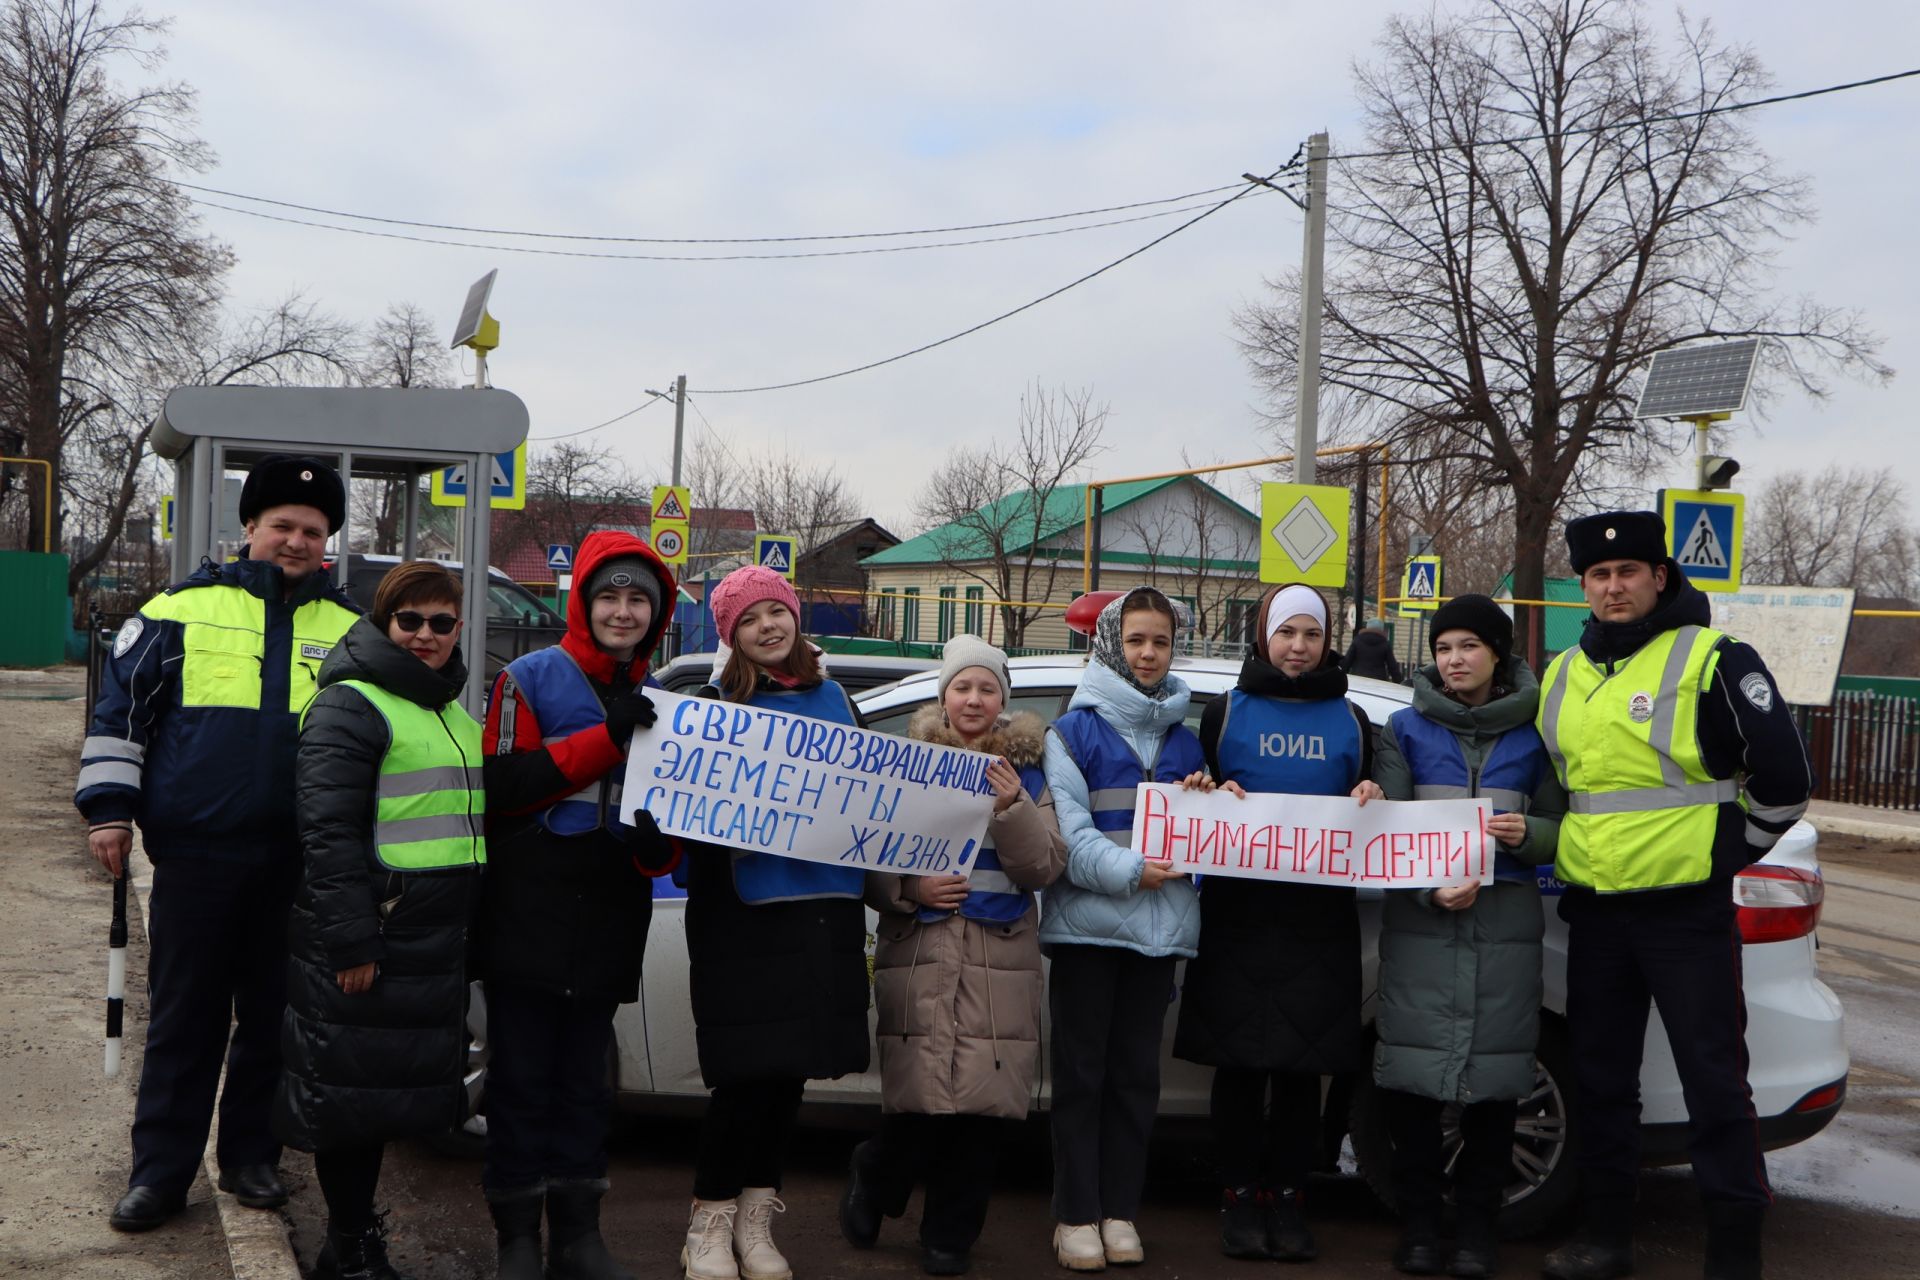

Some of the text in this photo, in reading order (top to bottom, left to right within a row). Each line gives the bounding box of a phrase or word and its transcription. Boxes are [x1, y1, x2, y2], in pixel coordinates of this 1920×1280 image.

[661, 538, 677, 550] 40
[304, 646, 321, 655] ДПС
[1259, 733, 1326, 760] ЮИД
[653, 740, 902, 823] ЭЛЕМЕНТЫ
[643, 786, 976, 876] СПАСАЮТ ЖИЗНЬ!
